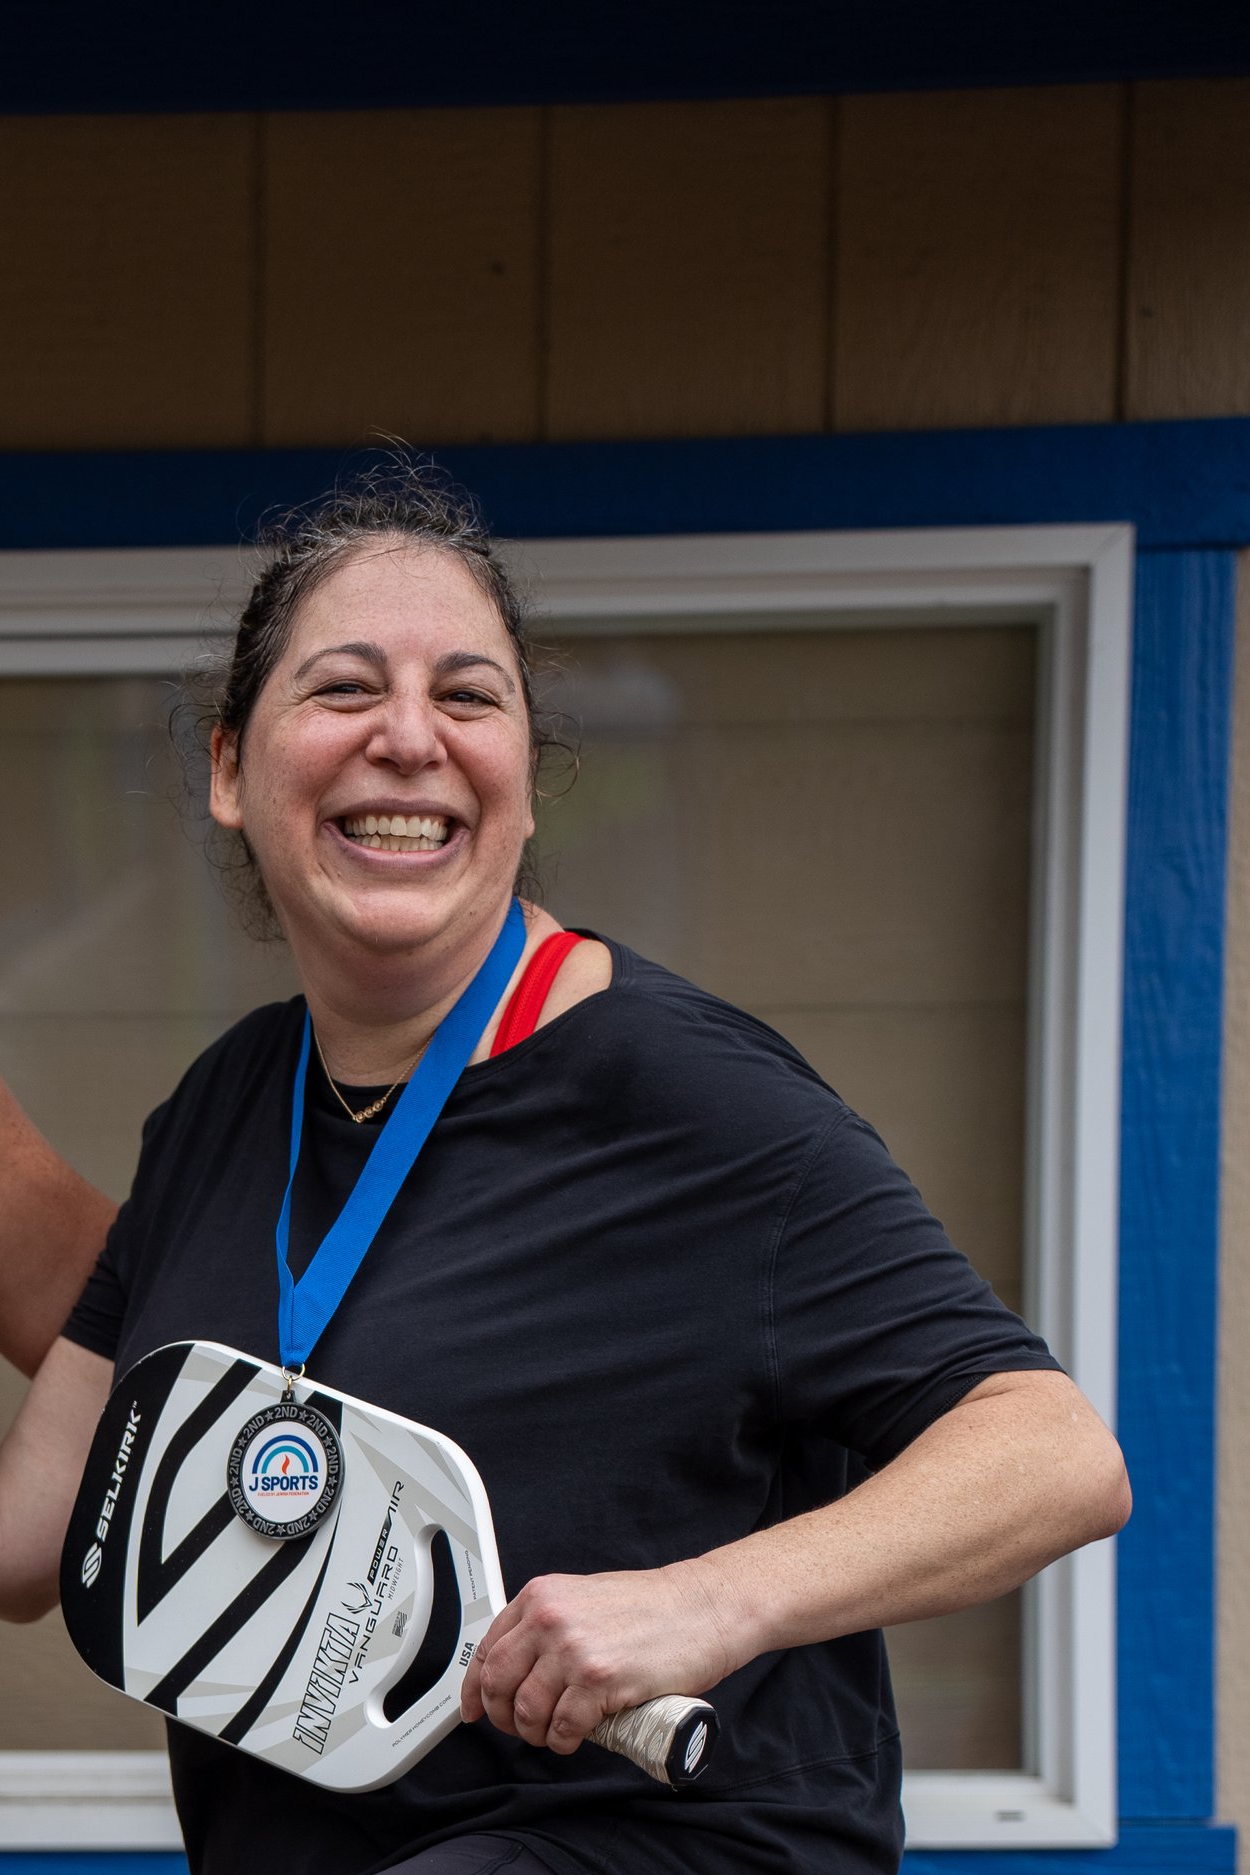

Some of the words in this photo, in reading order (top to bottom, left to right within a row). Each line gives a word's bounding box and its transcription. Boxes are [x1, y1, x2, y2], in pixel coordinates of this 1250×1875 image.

[275, 1406, 298, 1418] 2ND
[243, 1415, 265, 1439] 2ND
[307, 1415, 328, 1437] 2ND
[230, 1447, 242, 1474] 2ND
[327, 1447, 338, 1474] 2ND
[96, 1408, 141, 1542] SELKIRK
[249, 1476, 259, 1491] J
[261, 1475, 318, 1491] SPORTS
[231, 1487, 249, 1513] 2ND
[316, 1487, 334, 1513] 2ND
[252, 1518, 276, 1535] 2ND
[287, 1516, 310, 1534] 2ND
[369, 1528, 388, 1580] POWER
[387, 1557, 404, 1600] MIDWEIGHT
[348, 1546, 398, 1684] VANGUARD
[459, 1642, 474, 1667] USA
[292, 1612, 360, 1755] INVIKTA
